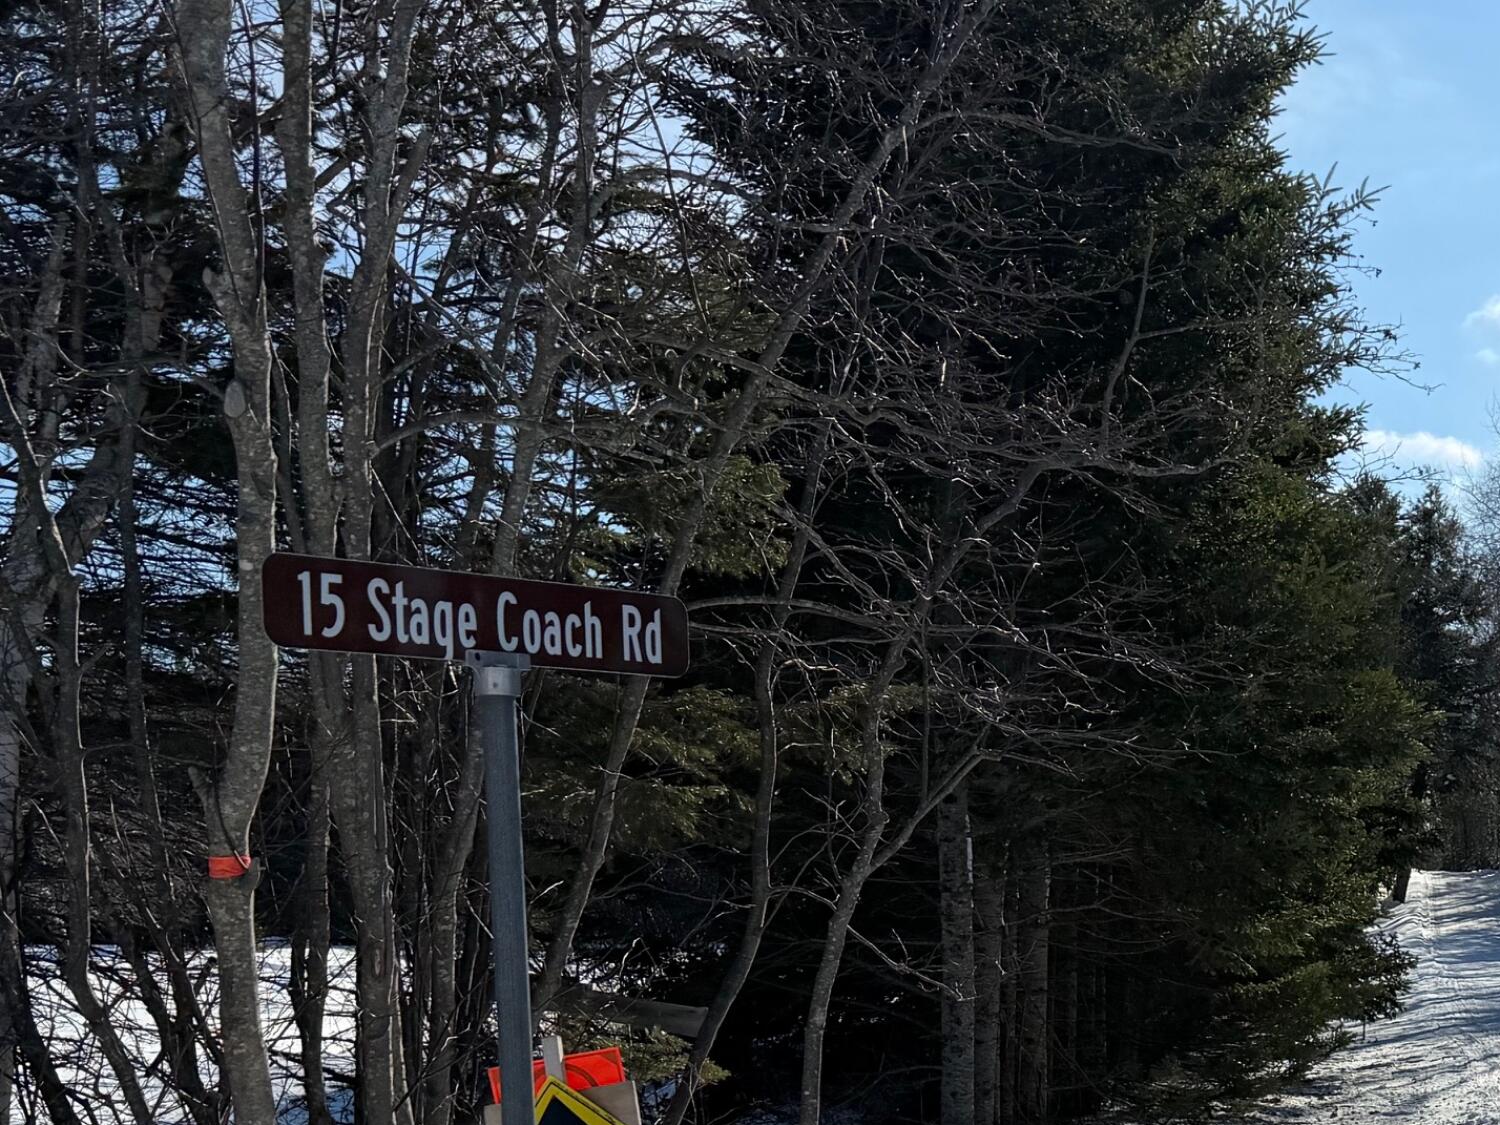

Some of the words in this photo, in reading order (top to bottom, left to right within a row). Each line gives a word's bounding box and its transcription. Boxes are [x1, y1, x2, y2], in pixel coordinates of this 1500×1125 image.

[297, 571, 345, 638] 15
[367, 577, 477, 660] Stage
[497, 591, 603, 659] Coach
[621, 603, 662, 664] Rd
